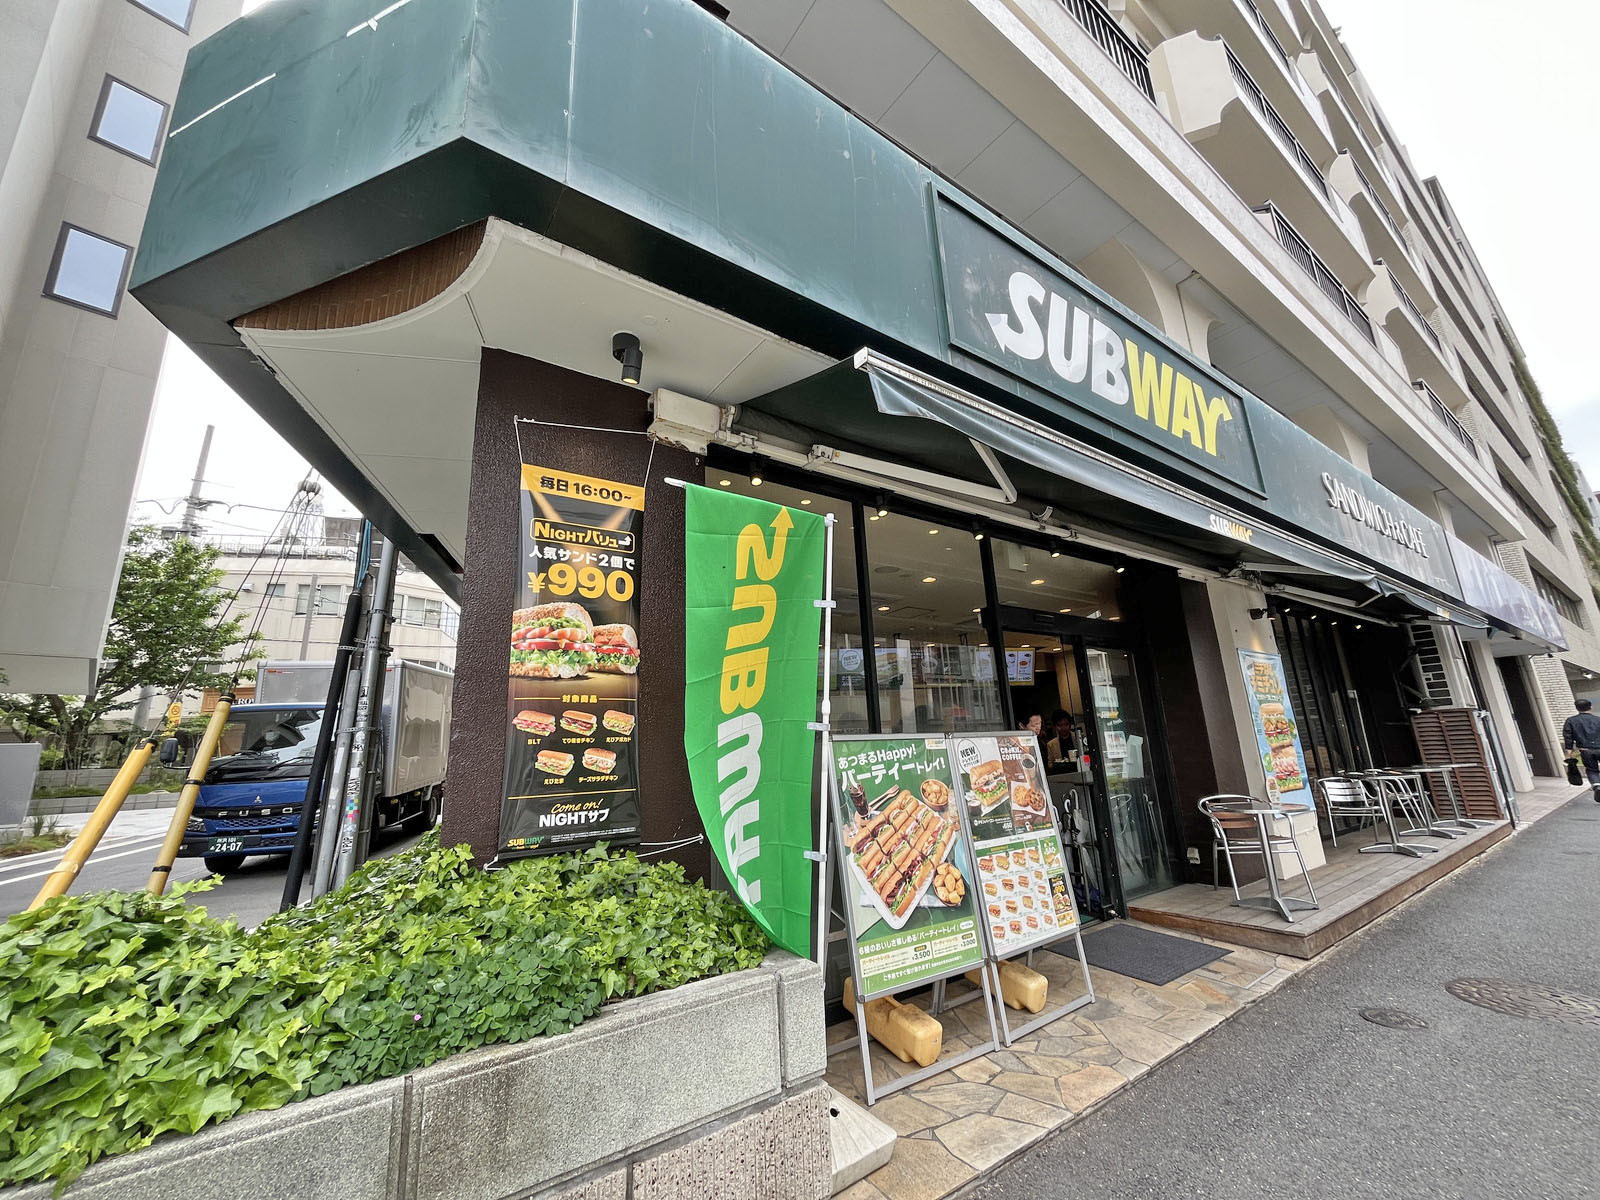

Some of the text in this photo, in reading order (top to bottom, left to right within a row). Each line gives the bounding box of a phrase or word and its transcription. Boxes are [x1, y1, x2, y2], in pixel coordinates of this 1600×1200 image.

[985, 272, 1232, 456] SUBWAY
[540, 475, 569, 492] 毎日
[1209, 513, 1253, 543] SUBWAY
[529, 545, 635, 570] 人気サンド2個で
[527, 563, 634, 602] ¥990
[838, 744, 917, 770] あつまるHappy!
[960, 746, 976, 758] NEW
[841, 757, 946, 792] パーティートレイ!
[217, 807, 293, 818] FUSO
[551, 798, 604, 814] Come on!
[214, 841, 243, 853] 24-07
[507, 836, 545, 848] SUBWAY
